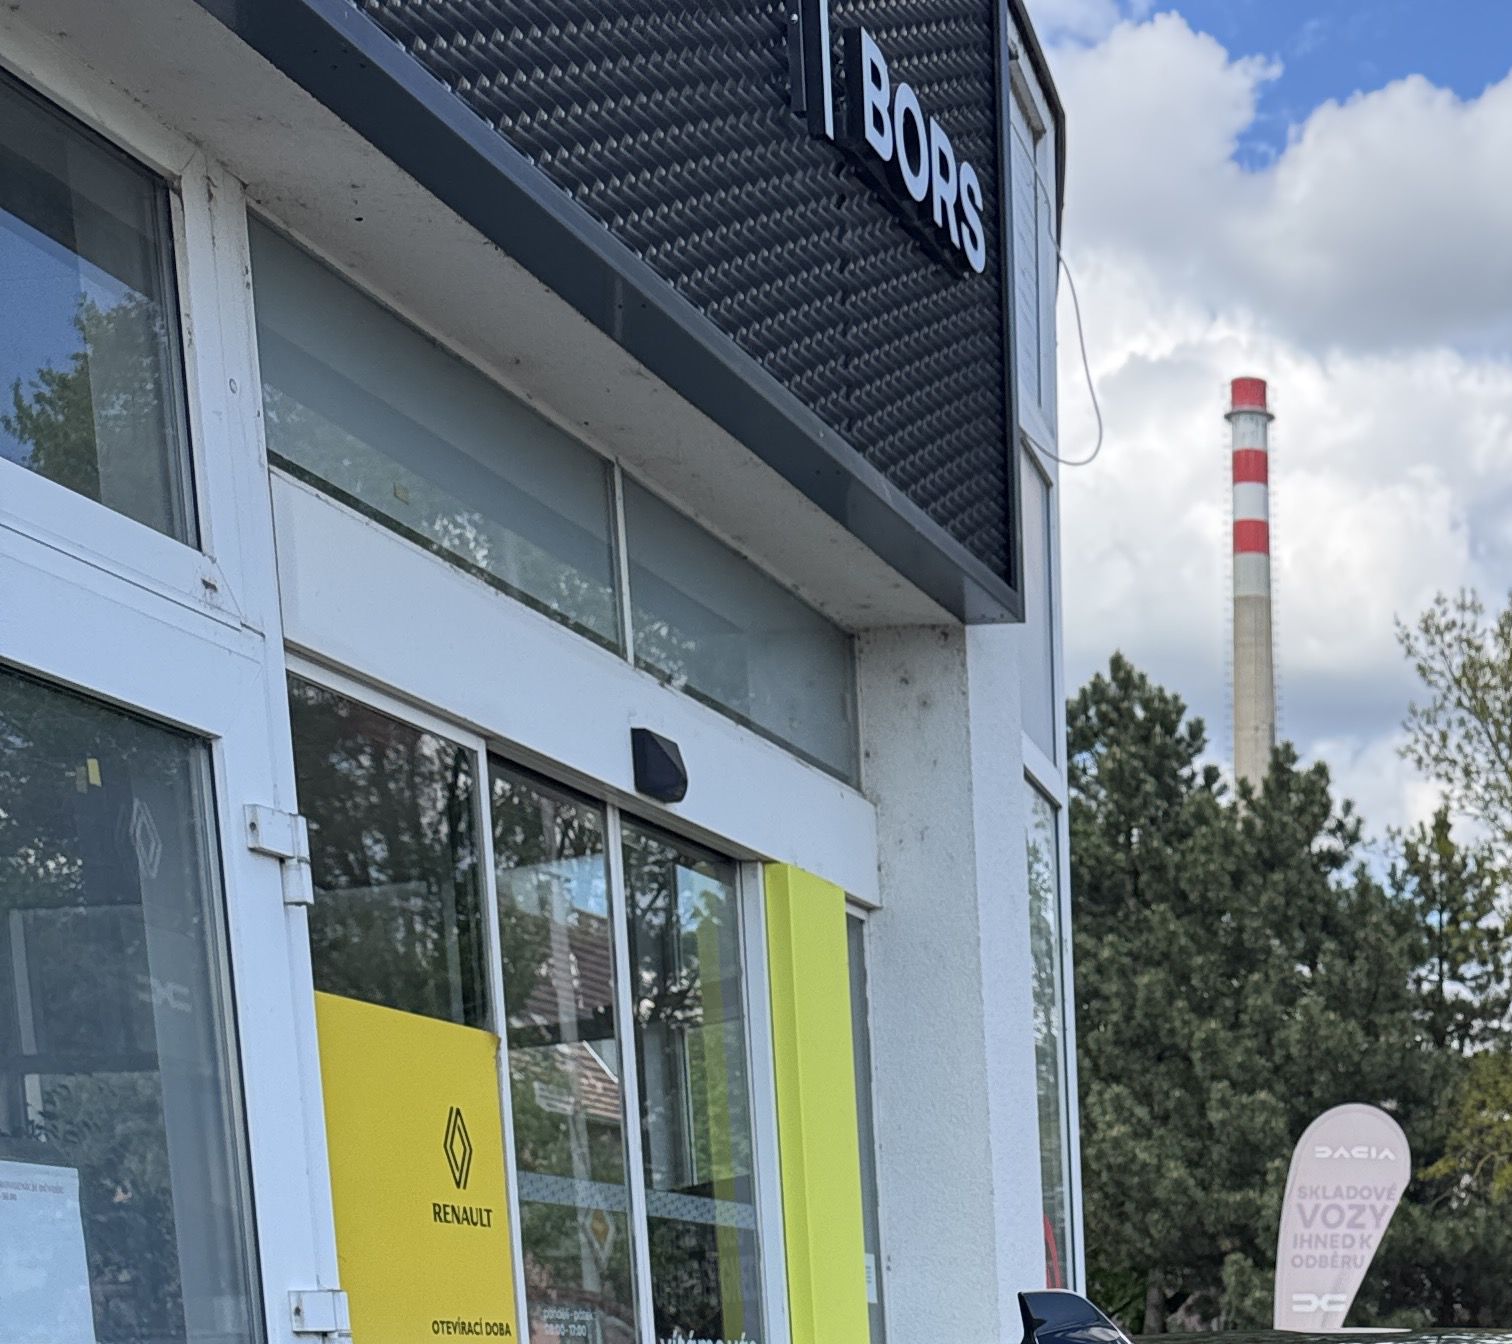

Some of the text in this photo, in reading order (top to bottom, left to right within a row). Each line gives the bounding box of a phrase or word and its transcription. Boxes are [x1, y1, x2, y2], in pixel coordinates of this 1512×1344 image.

[861, 26, 986, 273] BORS
[1314, 1146, 1396, 1160] DACIA
[1299, 1183, 1398, 1200] SKLADOVÉ
[432, 1203, 493, 1228] RENAULT
[1297, 1204, 1391, 1229] VOZY
[1292, 1233, 1374, 1249] IHNED K
[432, 1316, 512, 1336] OTEVÍRACÍ DOBA
